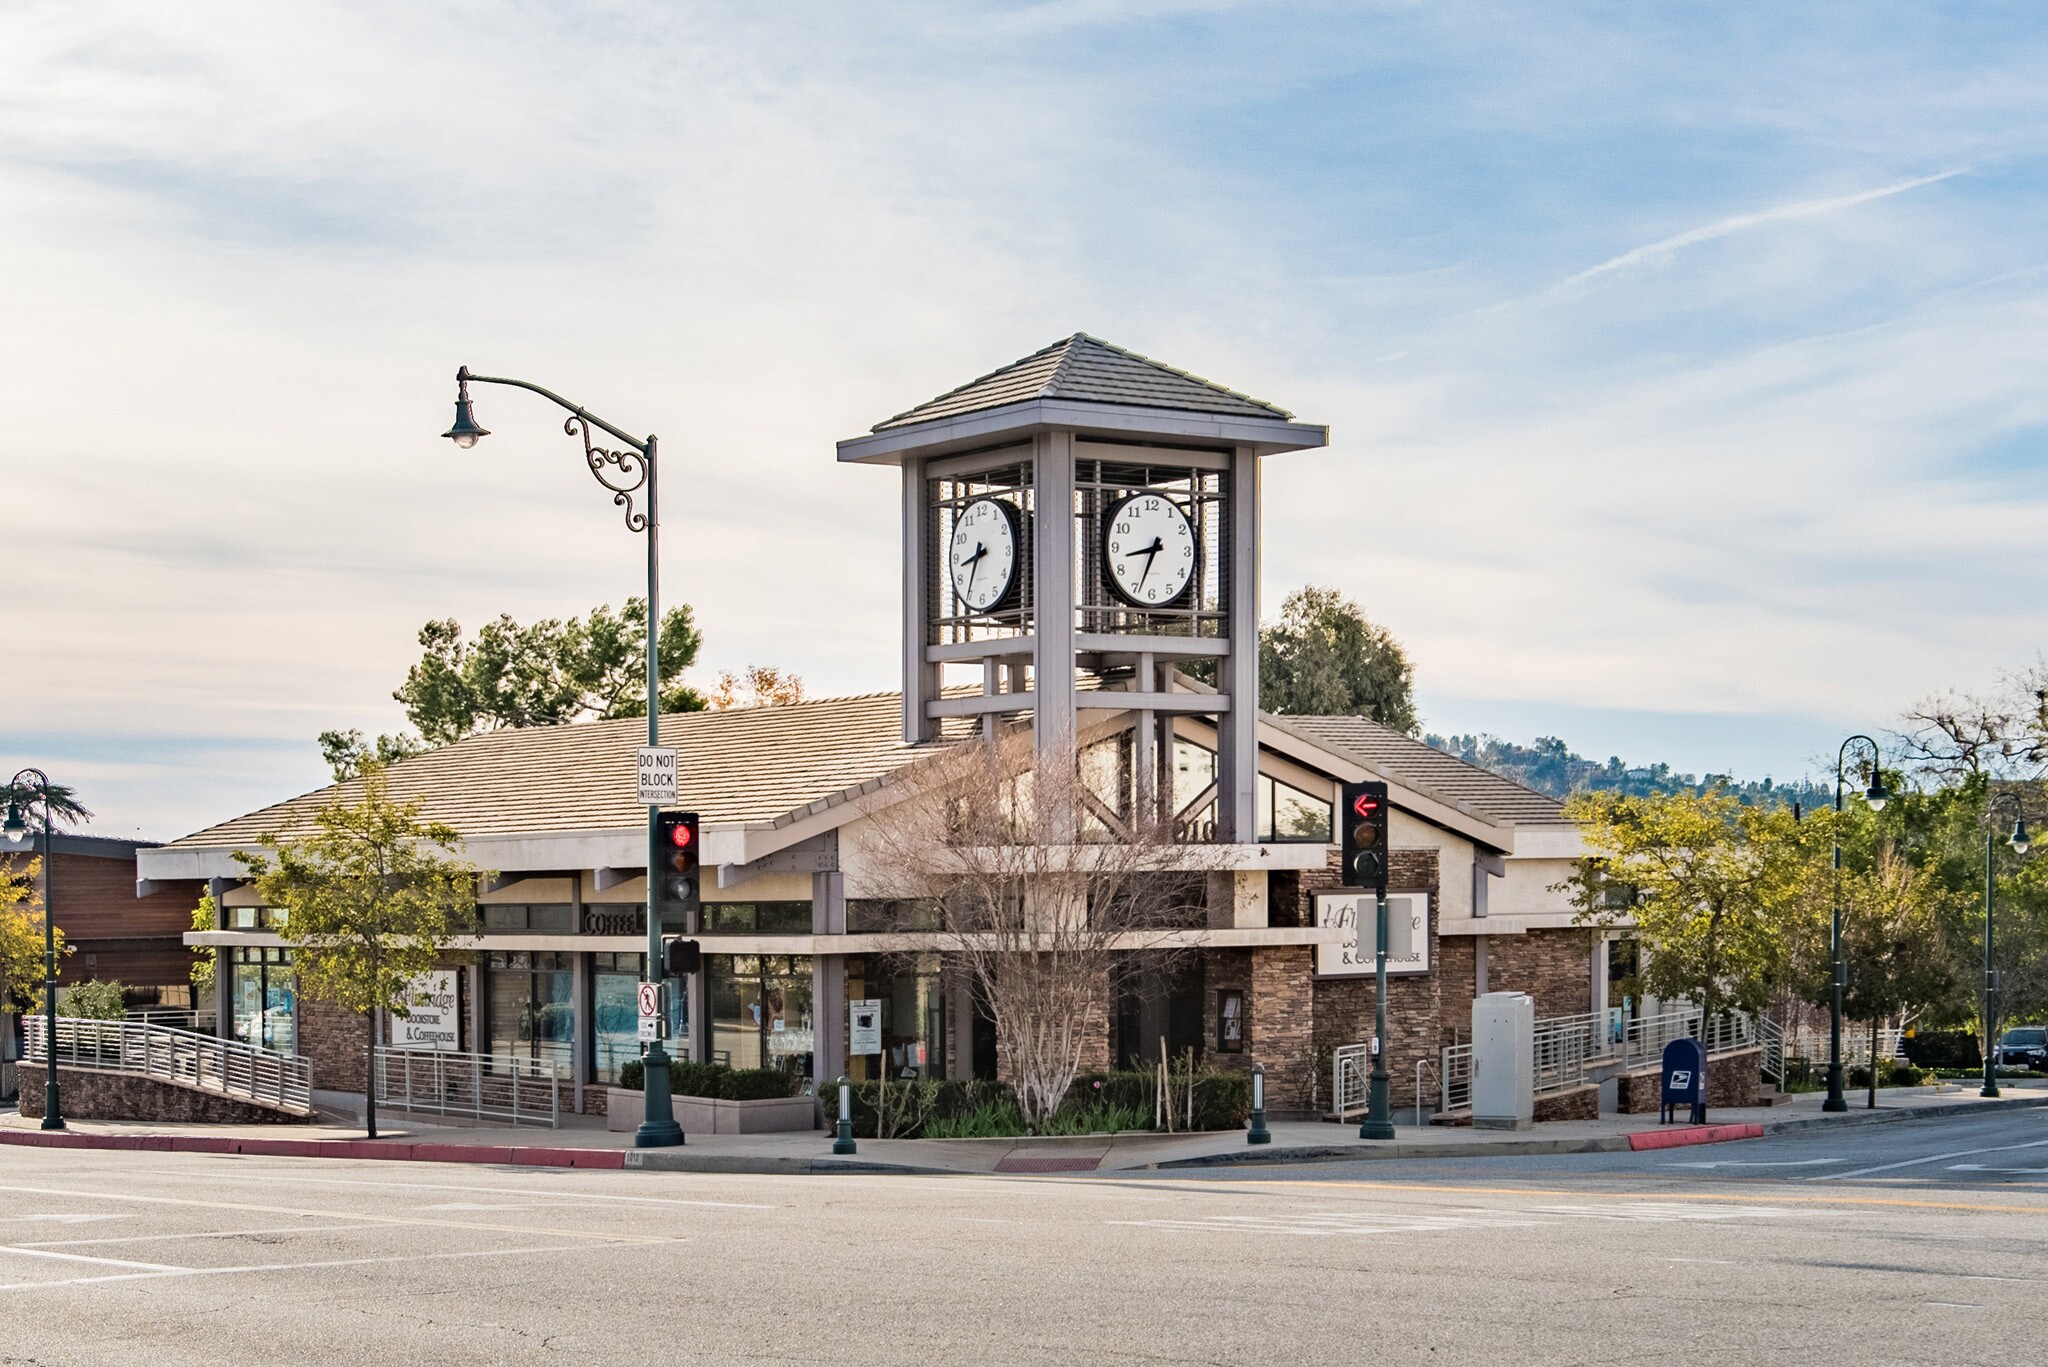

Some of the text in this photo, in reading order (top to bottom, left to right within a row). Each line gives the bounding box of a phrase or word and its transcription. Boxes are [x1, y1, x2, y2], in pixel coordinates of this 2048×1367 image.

[976, 504, 988, 517] 12
[1128, 506, 1141, 518] 11
[1144, 500, 1159, 512] 12
[993, 509, 998, 520] 1
[1168, 507, 1174, 518] 1
[965, 515, 974, 527] 11
[1001, 524, 1007, 535] 2
[1116, 522, 1130, 534] 10
[1178, 524, 1187, 536] 2
[956, 533, 967, 545] 10
[1005, 545, 1011, 557] 3
[1111, 541, 1119, 553] 9
[1183, 546, 1191, 558] 3
[953, 553, 959, 564] 9
[1001, 568, 1007, 579] 4
[1117, 564, 1125, 576] 8
[1177, 567, 1186, 579] 4
[957, 574, 964, 585] 8
[992, 586, 998, 598] 5
[1131, 582, 1139, 594] 7
[1166, 584, 1174, 595] 5
[979, 593, 985, 605] 6
[1148, 589, 1156, 600] 6
[640, 755, 674, 767] DO NOT
[641, 774, 673, 786] BLOCK
[639, 790, 675, 799] INTERSECTION
[585, 912, 634, 934] COFFEE
[1342, 952, 1352, 965] &
[406, 1027, 456, 1042] & COFFEEHOUSE
